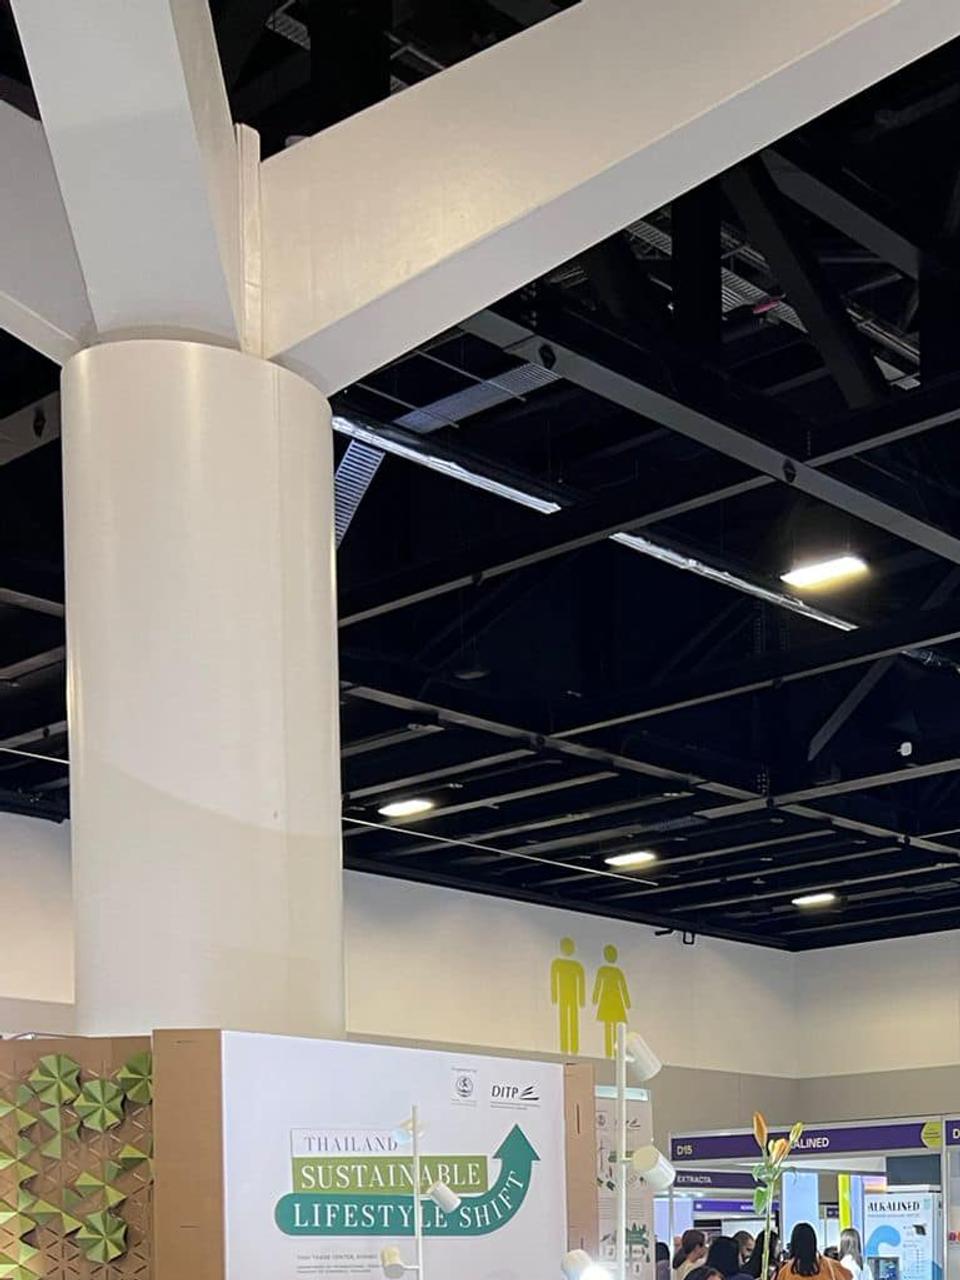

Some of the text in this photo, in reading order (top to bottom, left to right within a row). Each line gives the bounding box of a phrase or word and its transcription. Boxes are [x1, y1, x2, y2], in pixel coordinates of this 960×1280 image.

[491, 1085, 519, 1099] DITP
[303, 1136, 398, 1152] THAILAND
[676, 1145, 693, 1156] D15
[301, 1163, 481, 1189] SUSTAINABLE
[293, 1170, 524, 1228] LIFESTYLE SHIFT
[867, 1201, 920, 1212] ALKALINED
